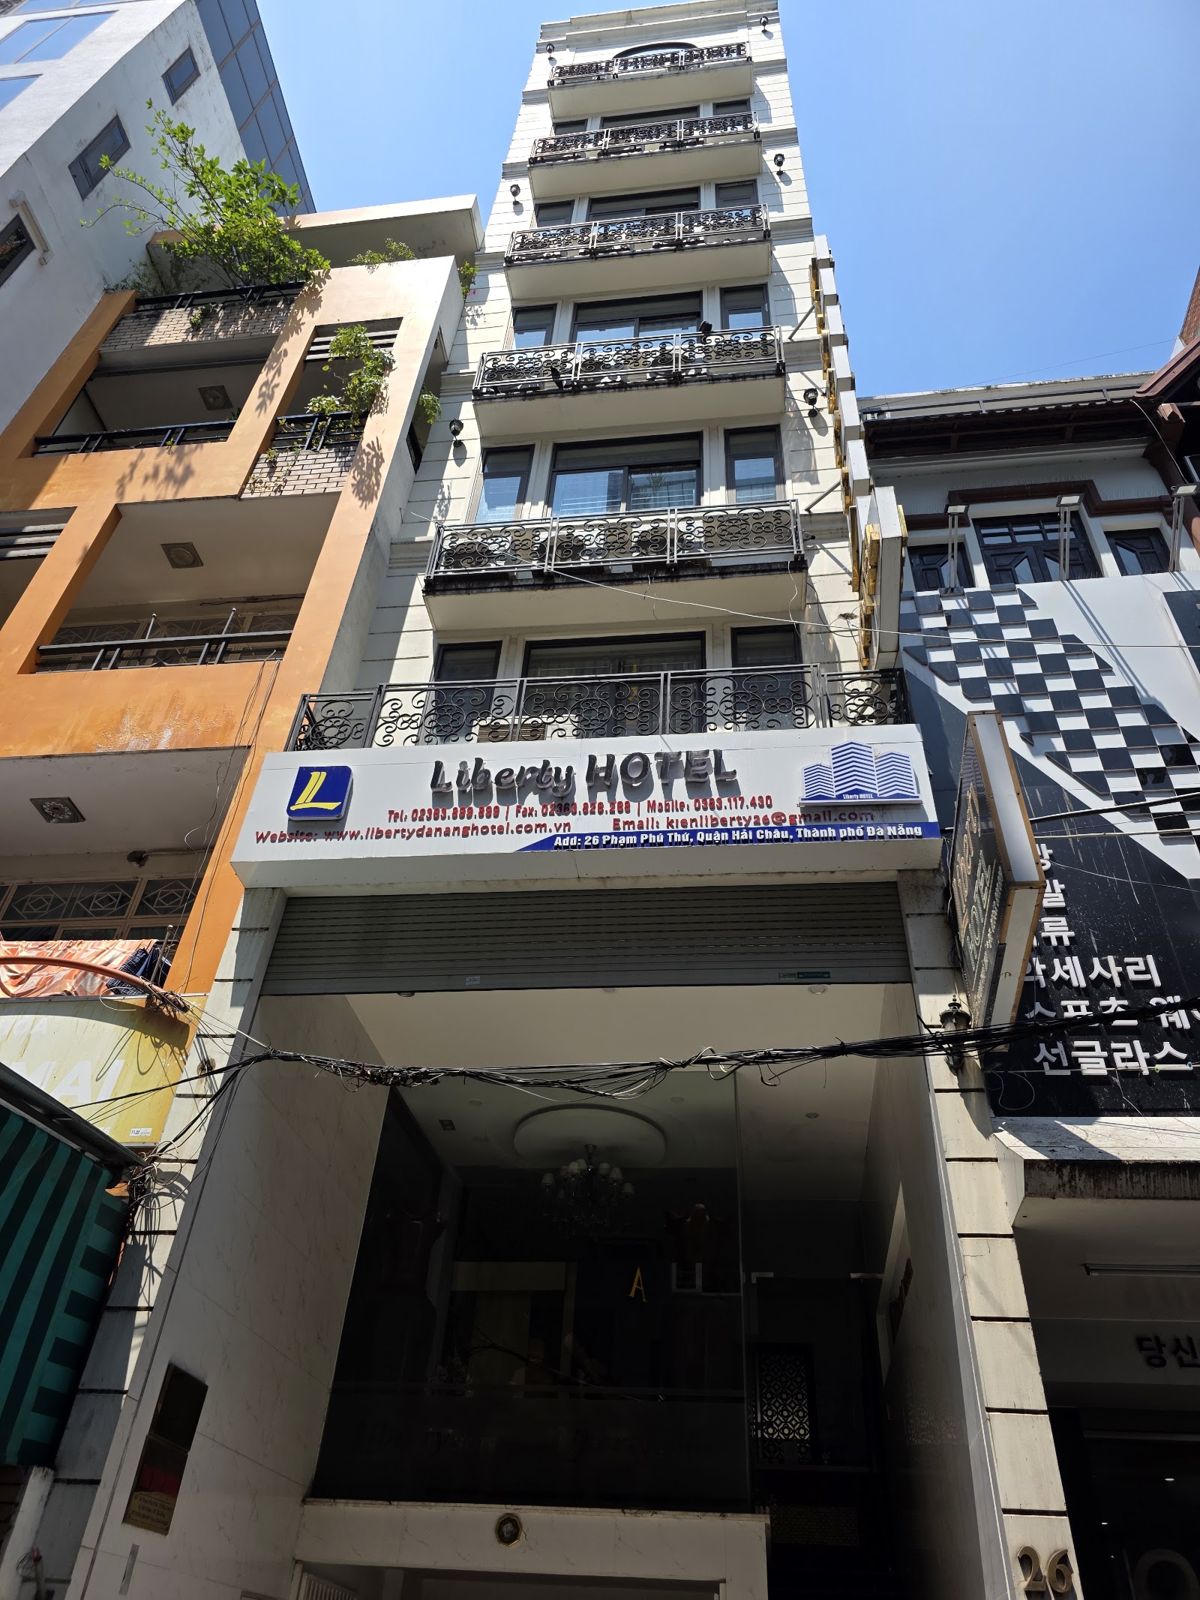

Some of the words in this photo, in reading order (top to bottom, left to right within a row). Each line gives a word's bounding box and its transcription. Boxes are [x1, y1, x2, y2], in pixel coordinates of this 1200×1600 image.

[430, 756, 577, 798] Liberty
[586, 749, 738, 787] HOTEL
[290, 771, 342, 811] L
[388, 809, 408, 823] Tel:
[515, 803, 538, 818] Fax:
[647, 799, 690, 814] Mobile:
[255, 830, 318, 844] Website:
[324, 821, 571, 842] www.libertydananghotel.com.vn
[612, 817, 660, 831] Email:
[554, 836, 581, 846] Add:
[584, 835, 599, 845] 26
[602, 834, 637, 847] Phạm
[640, 832, 664, 844] Phú
[697, 830, 729, 844] Quận
[732, 828, 753, 840] Hải
[756, 827, 794, 840] Châu,
[796, 826, 836, 839] Thành
[839, 824, 866, 839] phố
[887, 823, 922, 836] Nẵng
[1042, 879, 1066, 909] 발
[1033, 916, 1076, 947] 류
[1033, 1039, 1194, 1077] 선글라스
[1017, 1545, 1073, 1594] 26
